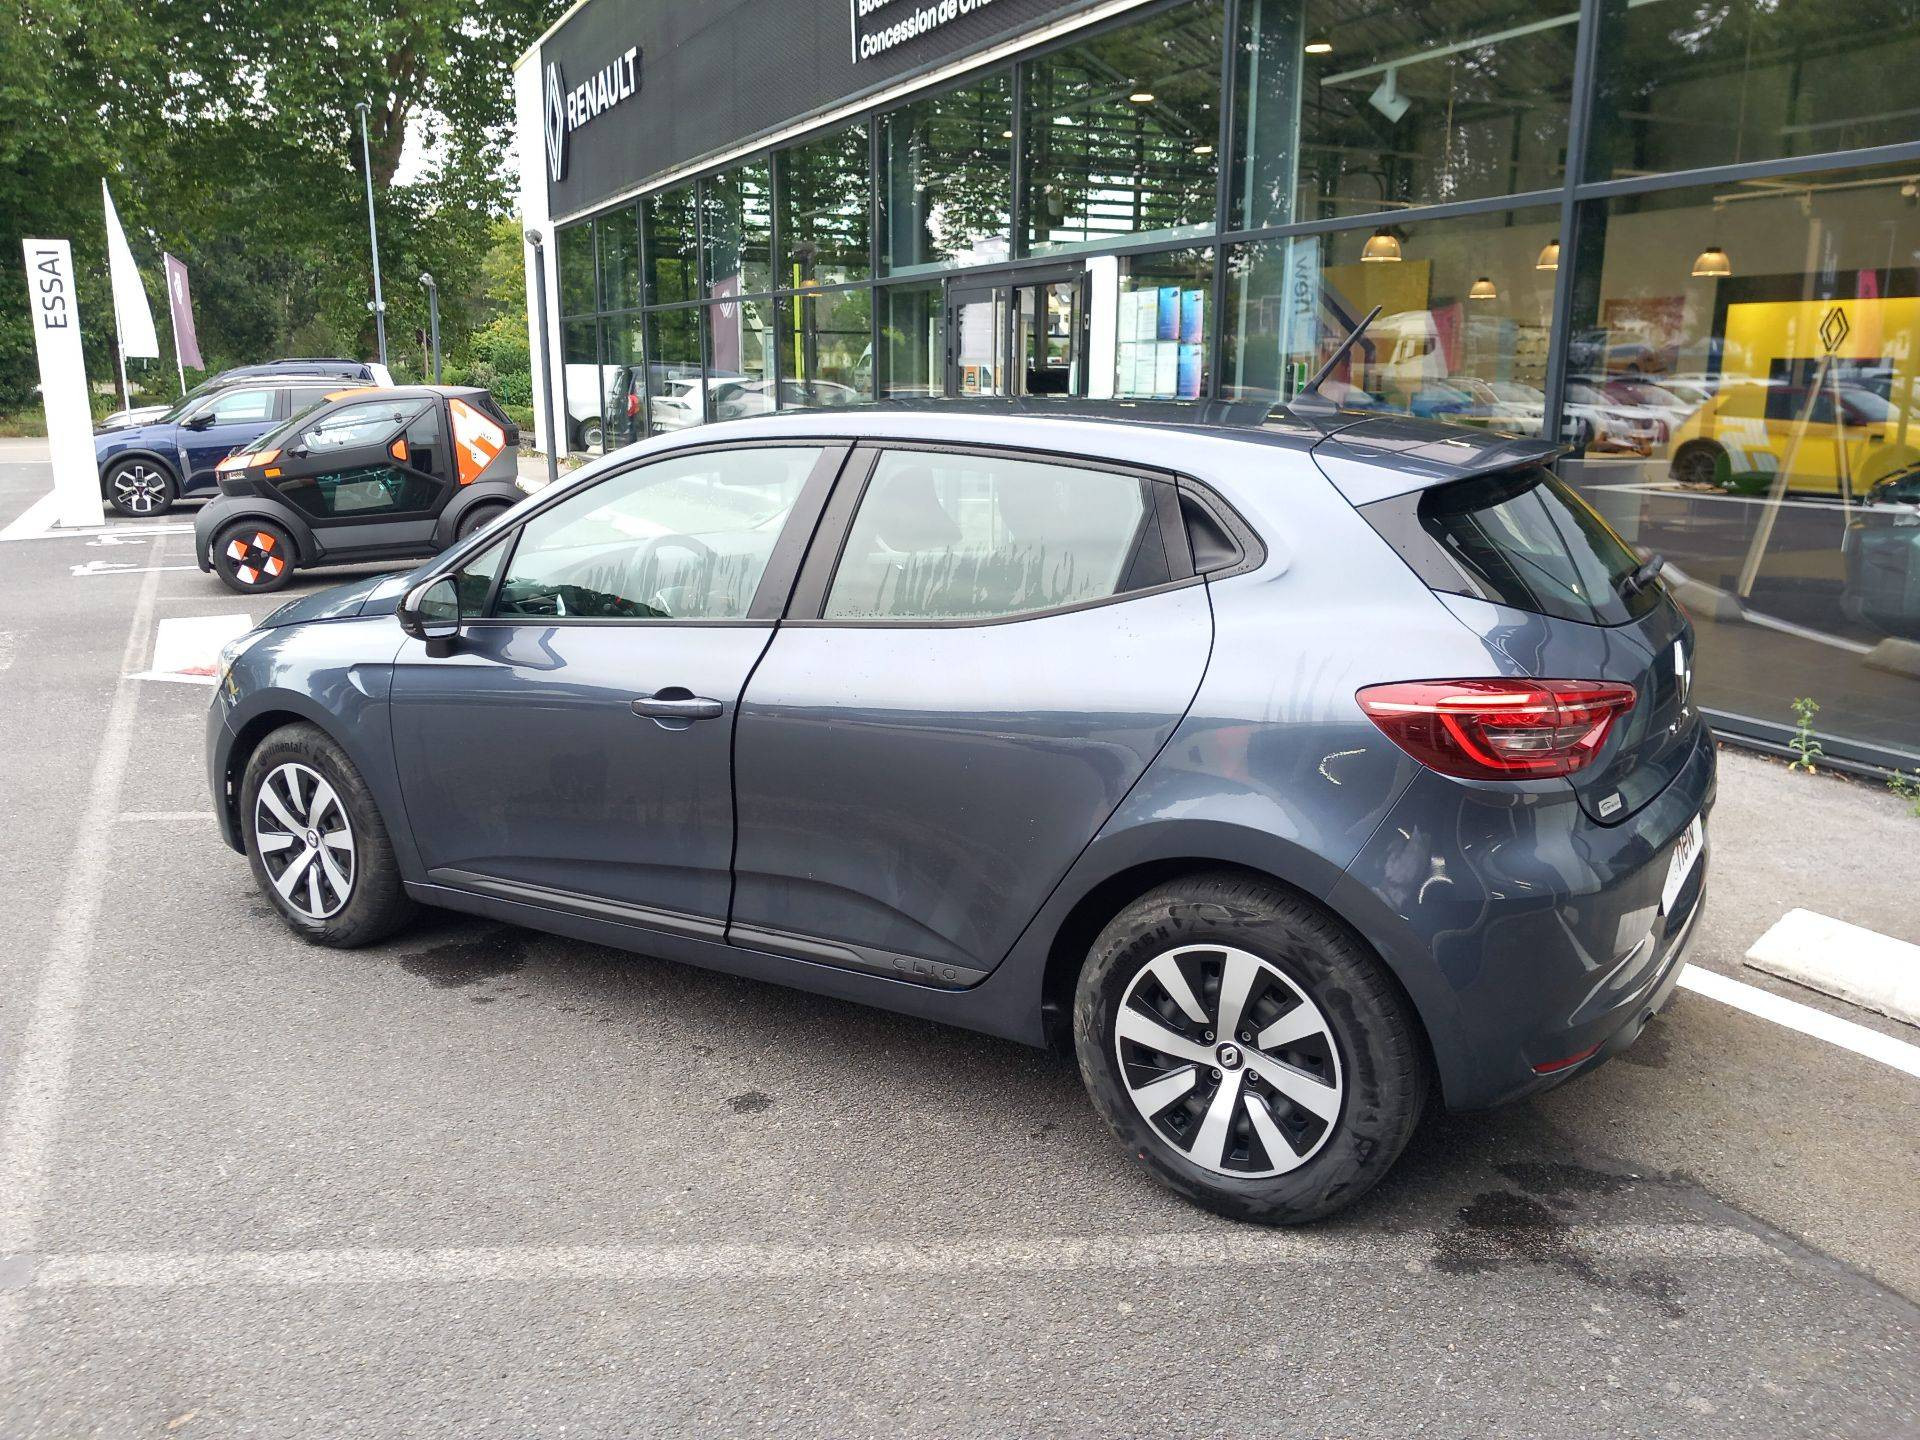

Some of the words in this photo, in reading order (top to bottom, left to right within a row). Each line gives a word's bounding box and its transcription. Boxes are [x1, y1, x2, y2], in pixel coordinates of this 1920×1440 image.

[860, 9, 937, 59] Concession
[937, 3, 957, 23] de
[566, 46, 637, 132] RENAULT
[36, 250, 67, 329] ESSAI
[892, 957, 958, 981] CLIO
